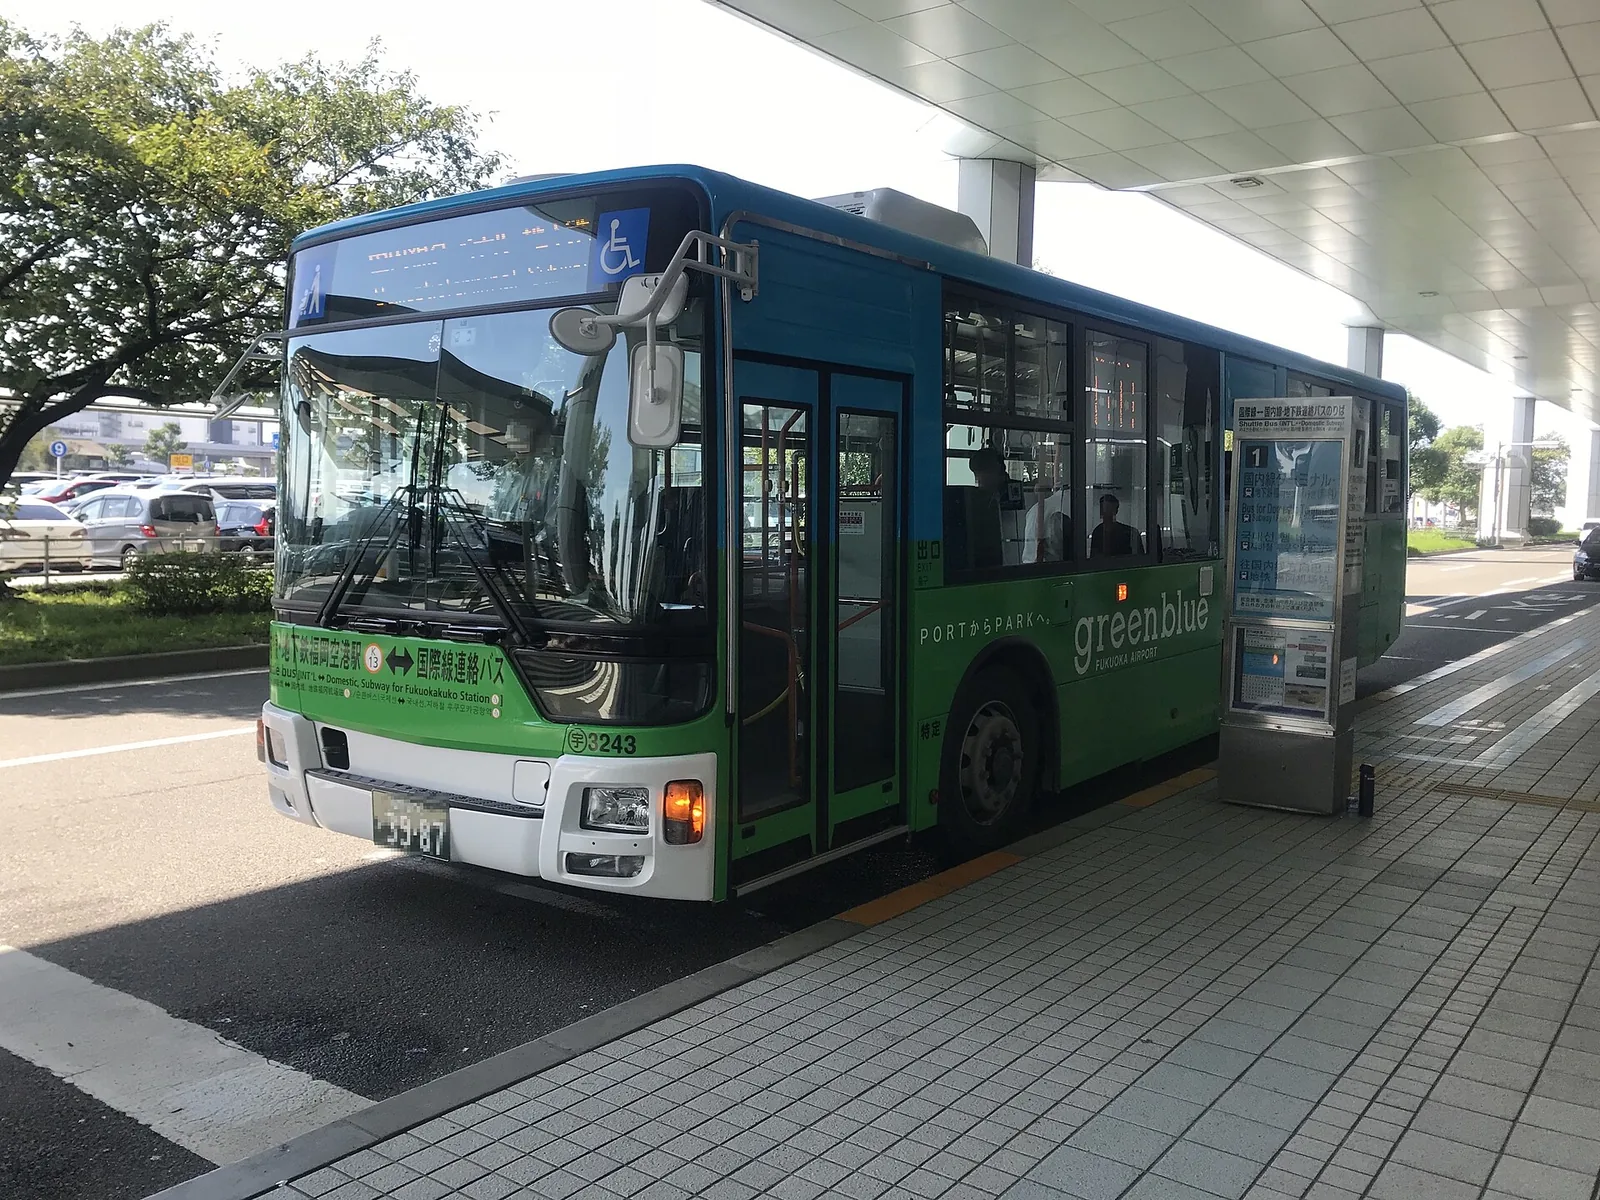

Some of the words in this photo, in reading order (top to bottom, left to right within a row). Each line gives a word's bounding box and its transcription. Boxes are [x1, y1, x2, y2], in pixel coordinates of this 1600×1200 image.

[55, 443, 64, 455] 9
[1252, 448, 1261, 467] 1
[917, 540, 941, 560] 出口
[917, 563, 932, 573] EXIT
[1074, 591, 1209, 675] greenblue
[368, 656, 379, 669] 13
[416, 648, 504, 685] 国際線連絡バス
[1096, 656, 1129, 671] FUKUOKA
[1130, 646, 1158, 662] AIRPORT
[361, 679, 390, 694] Subway
[392, 682, 403, 693] for
[405, 684, 458, 700] Fukuokakuko
[460, 691, 490, 704] Station
[920, 721, 941, 741] 特定
[588, 732, 637, 754] 3243
